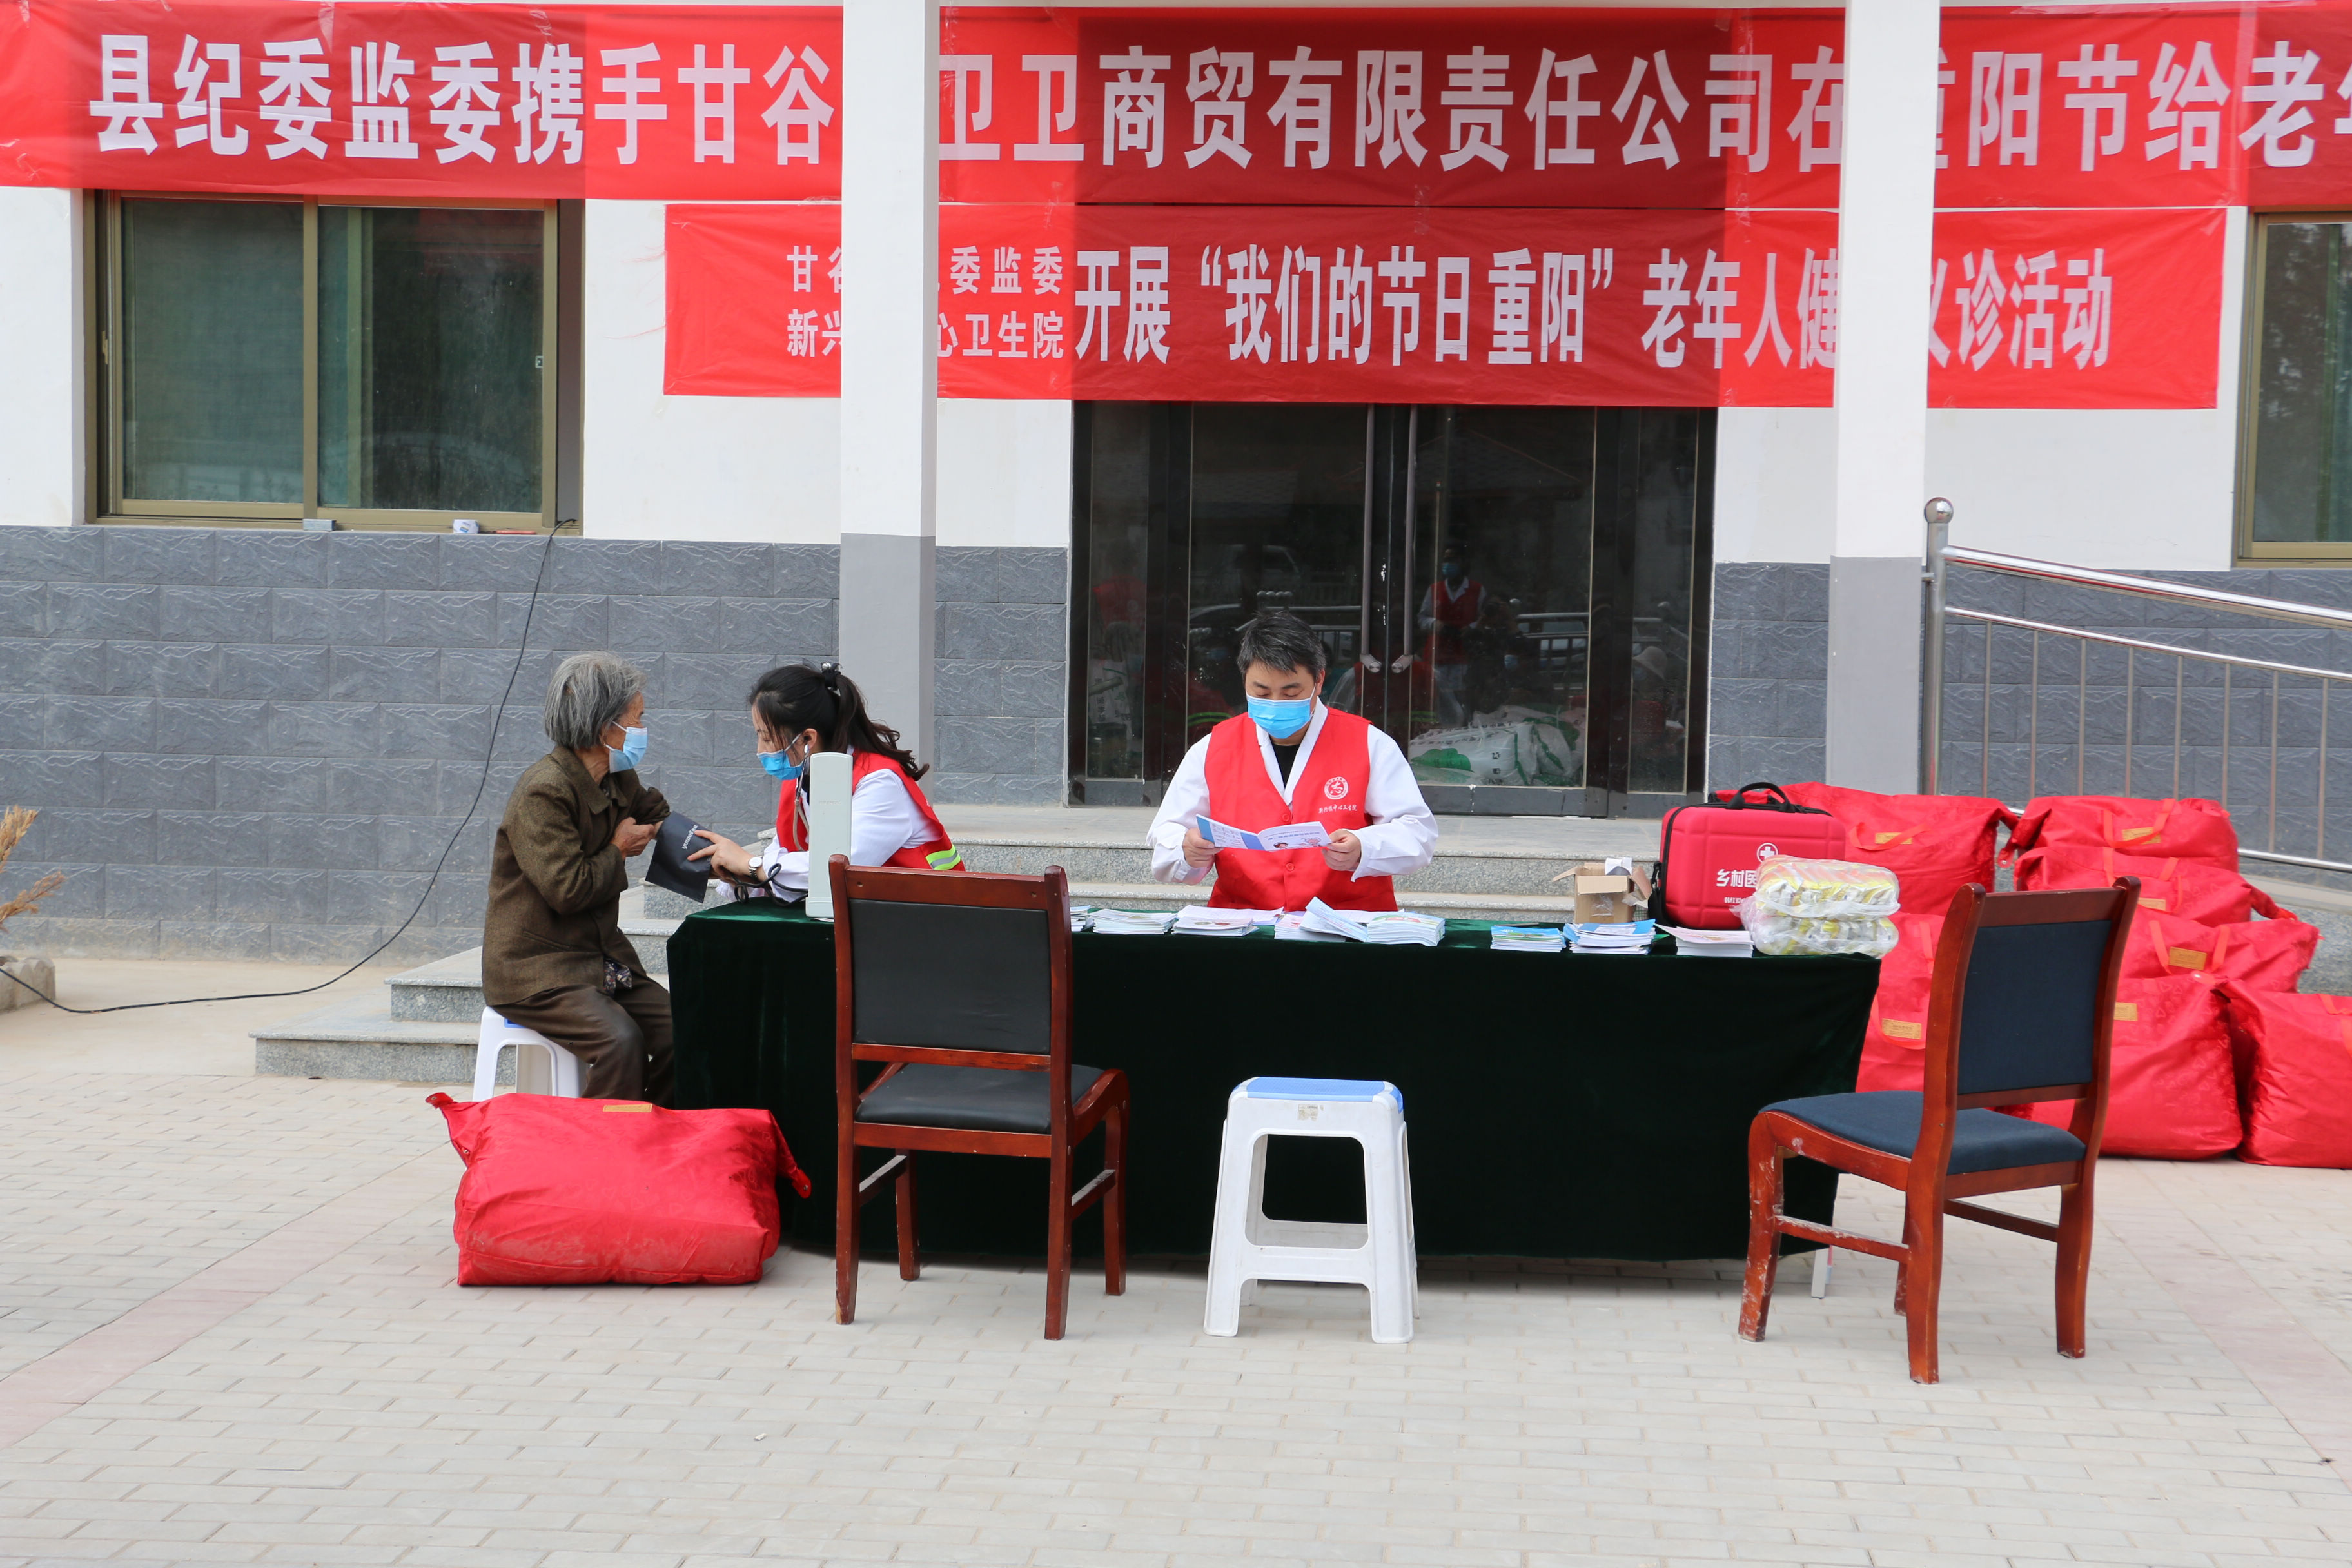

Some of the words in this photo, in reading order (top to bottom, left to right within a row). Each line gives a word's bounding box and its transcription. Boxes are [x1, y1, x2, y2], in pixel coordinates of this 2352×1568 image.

[90, 35, 2352, 173] 县纪委监委携手甘谷卫卫商贸有限责任公司在阳节给老
[787, 309, 1064, 358] 新兴心卫生院
